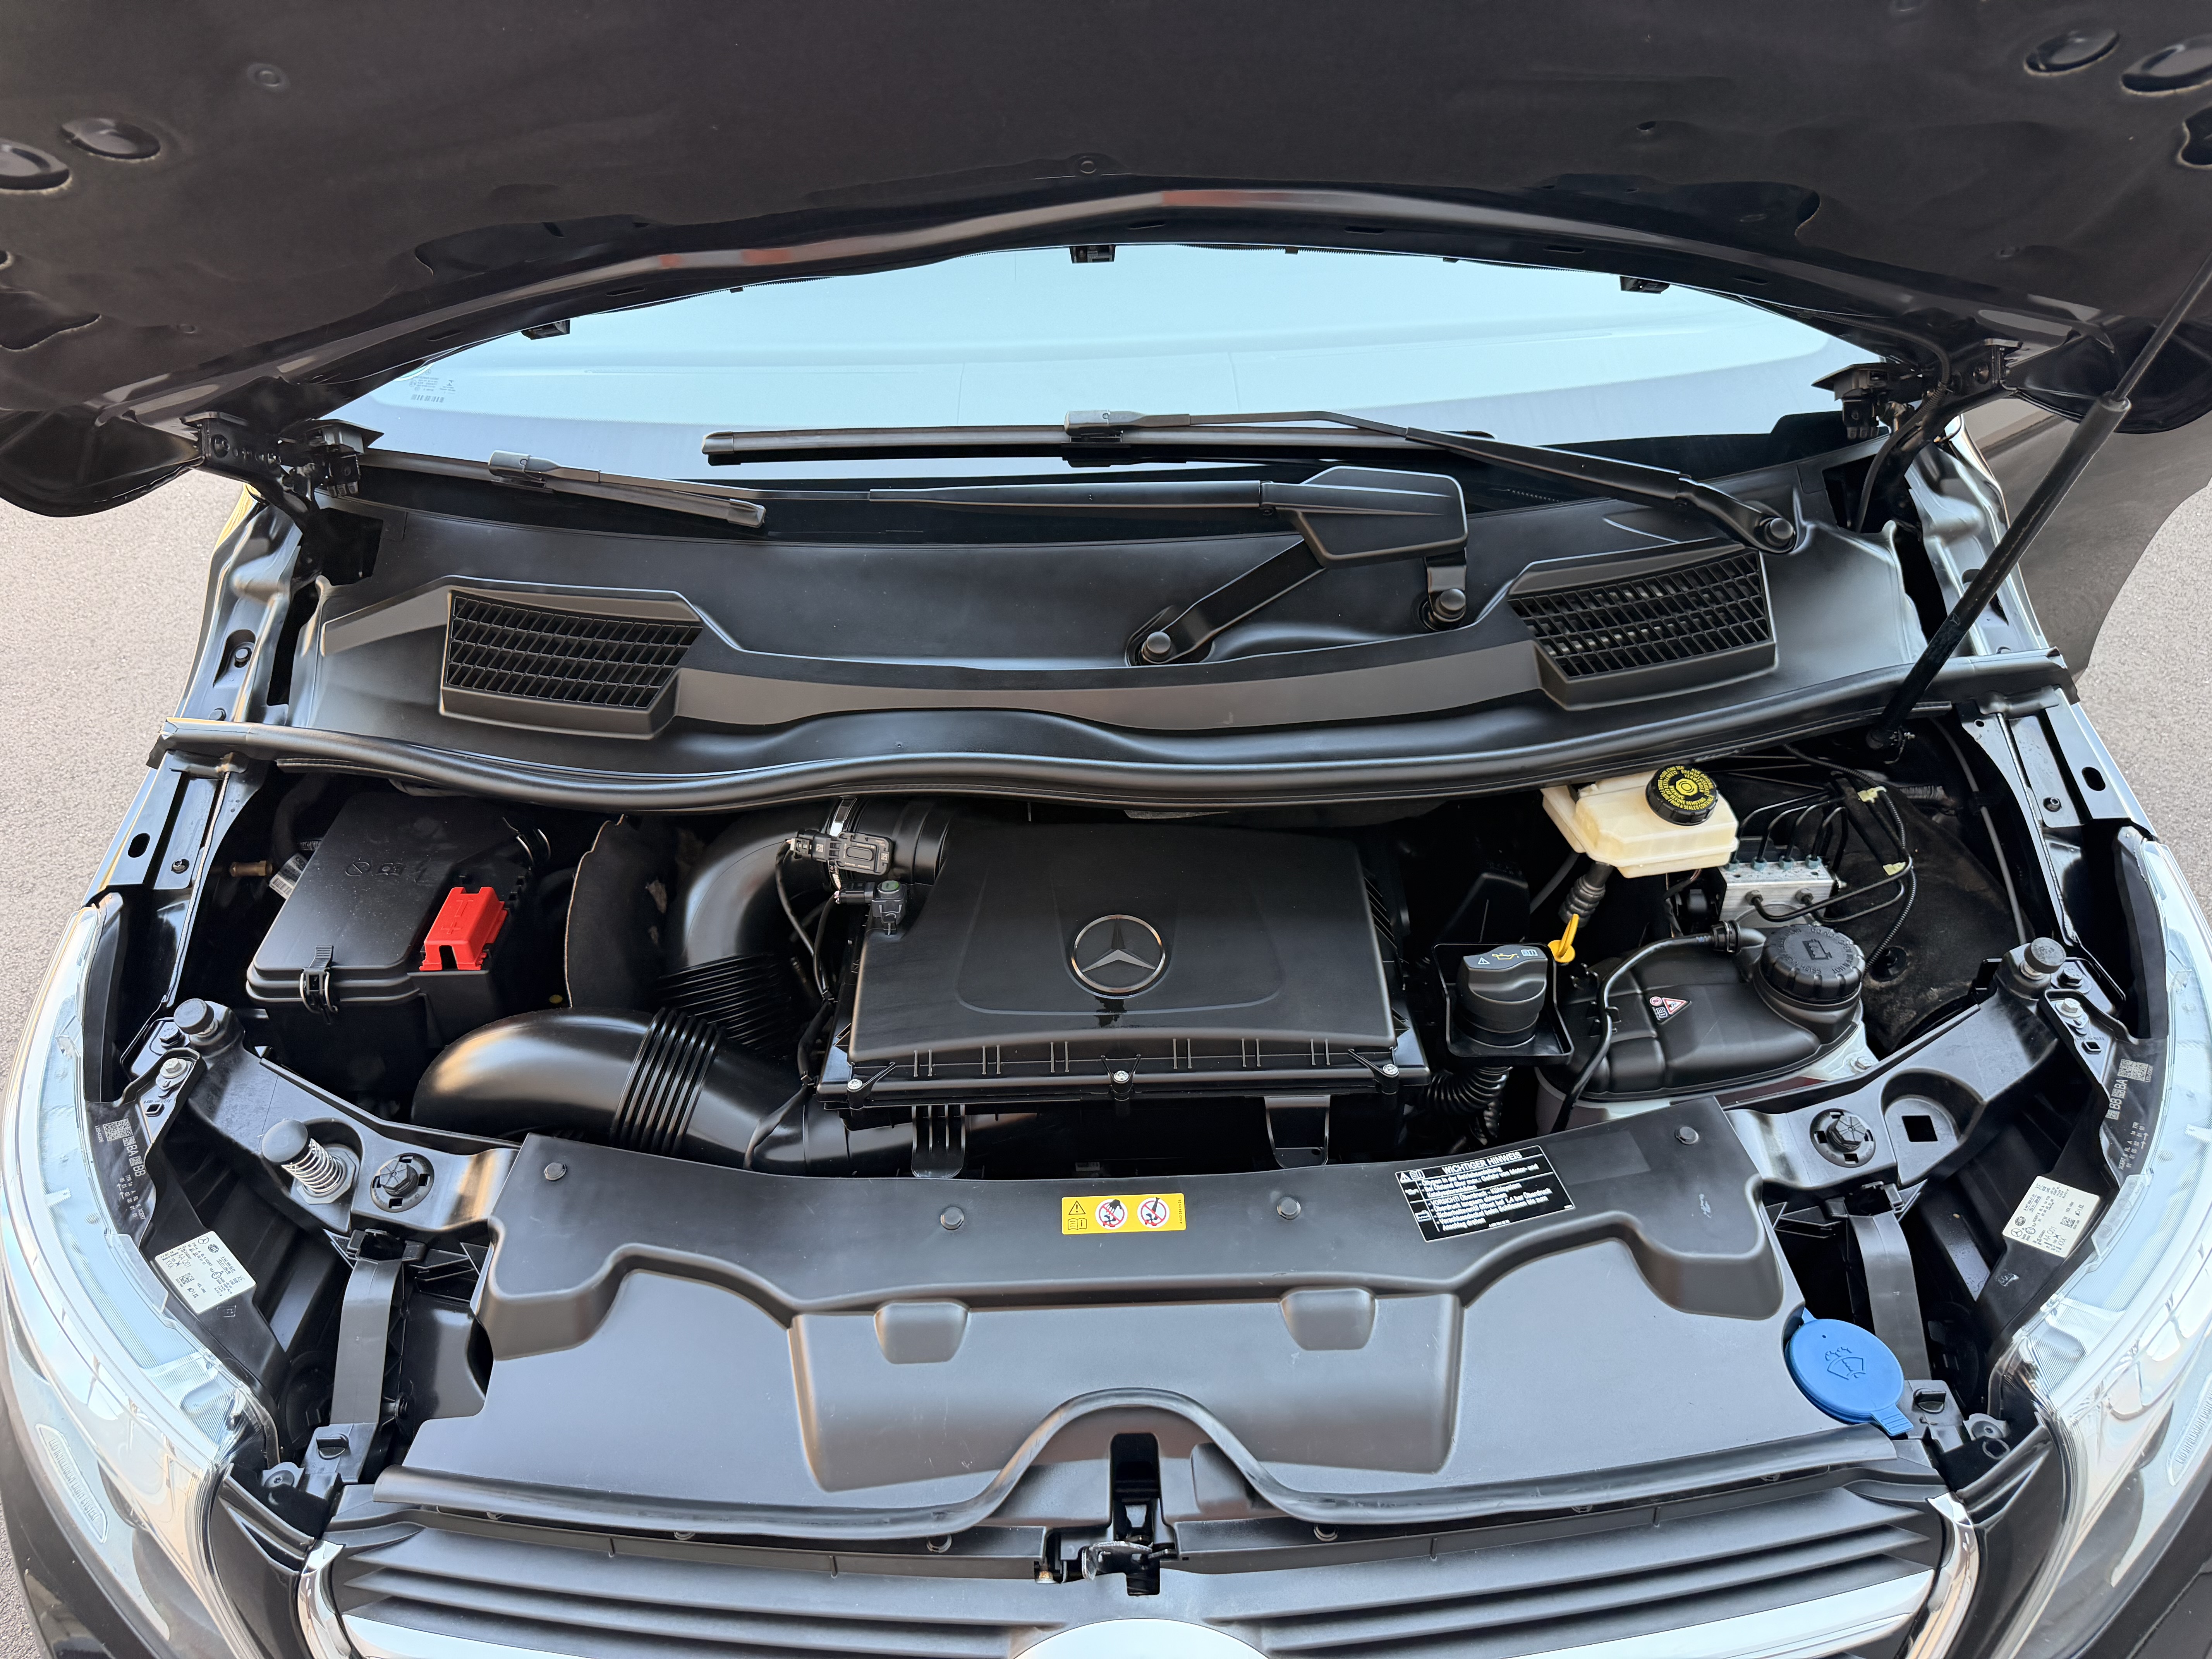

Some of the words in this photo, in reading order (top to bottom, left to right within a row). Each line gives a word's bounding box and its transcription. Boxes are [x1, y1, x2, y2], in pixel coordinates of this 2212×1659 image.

[1660, 790, 1670, 800] FLUID
[1669, 794, 1685, 804] BEFORE
[1798, 963, 1822, 974] HEISS
[1830, 964, 1846, 974] HOT
[2114, 1076, 2128, 1091] BA
[2108, 1096, 2123, 1110] BB
[125, 1144, 138, 1157] BA
[132, 1164, 146, 1178] BB
[1441, 1159, 1488, 1175] WICHTIGER
[1485, 1151, 1524, 1165] HINWEIS
[1456, 1166, 1503, 1181] Betriebsanleitung
[1480, 1172, 1501, 1182] Gefahr
[1525, 1163, 1540, 1171] und
[1458, 1188, 1488, 1201] Überdruck
[1432, 1200, 1462, 1213] Überdruck
[1435, 1204, 1480, 1219] Sicherheitsventil
[1477, 1200, 1497, 1210] öffnet
[1494, 1198, 1506, 1206] bei
[1512, 1194, 1525, 1202] bar
[1522, 1186, 1553, 1199] Überdruck
[1483, 1206, 1500, 1216] beim
[1534, 1195, 1549, 1204] zum
[1441, 1219, 1469, 1233] Anschlag
[1465, 1216, 1487, 1227] drehen
[2043, 1233, 2051, 1242] AA
[177, 1252, 185, 1261] AA
[48, 1437, 61, 1451] LED
[52, 1449, 78, 1484] INTELLIGENT
[70, 1481, 86, 1500] LIGHT
[79, 1496, 101, 1522] SYSTEM
